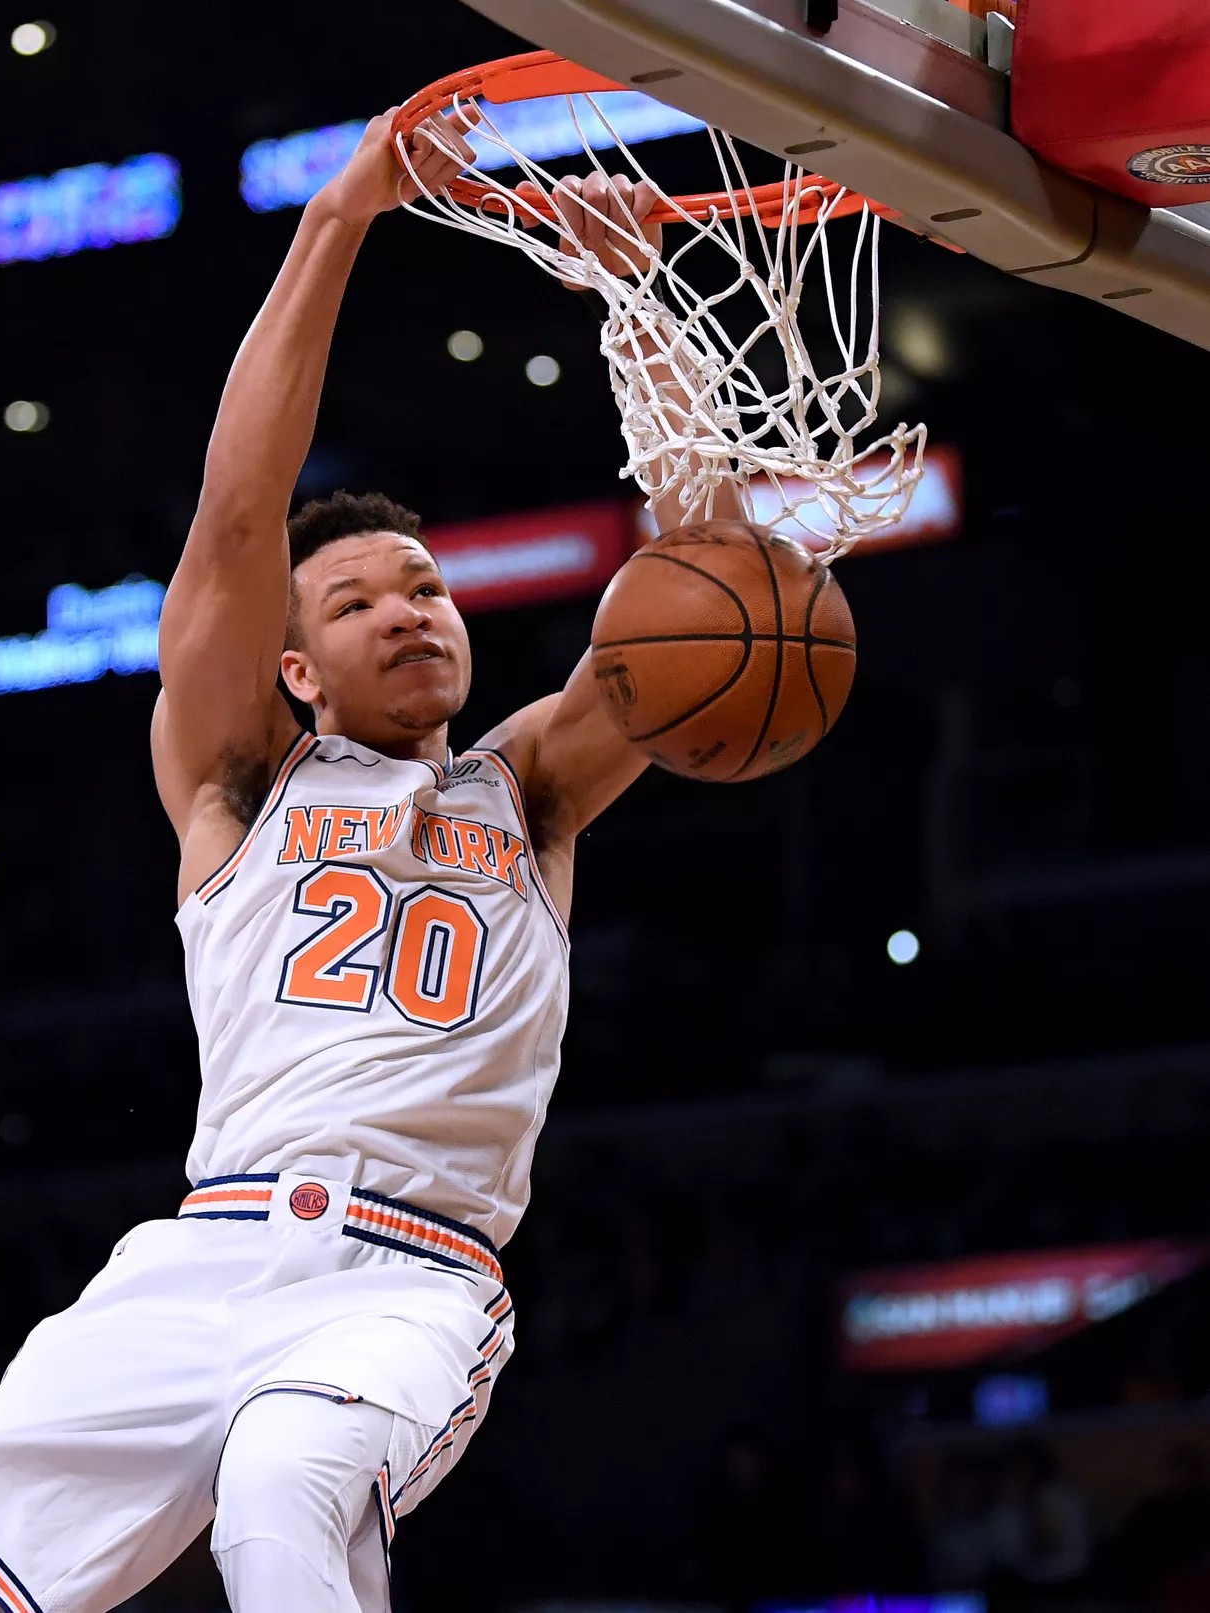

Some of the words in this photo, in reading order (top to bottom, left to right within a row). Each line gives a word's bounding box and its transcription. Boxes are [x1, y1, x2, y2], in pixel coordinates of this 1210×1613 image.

[1167, 157, 1210, 172] AA
[1140, 172, 1210, 184] SOUTHER
[440, 777, 501, 793] QUARESPACE
[277, 791, 413, 865] NEW
[411, 804, 527, 903] YORK
[275, 860, 488, 1032] 20
[293, 1191, 325, 1210] KNICKS
